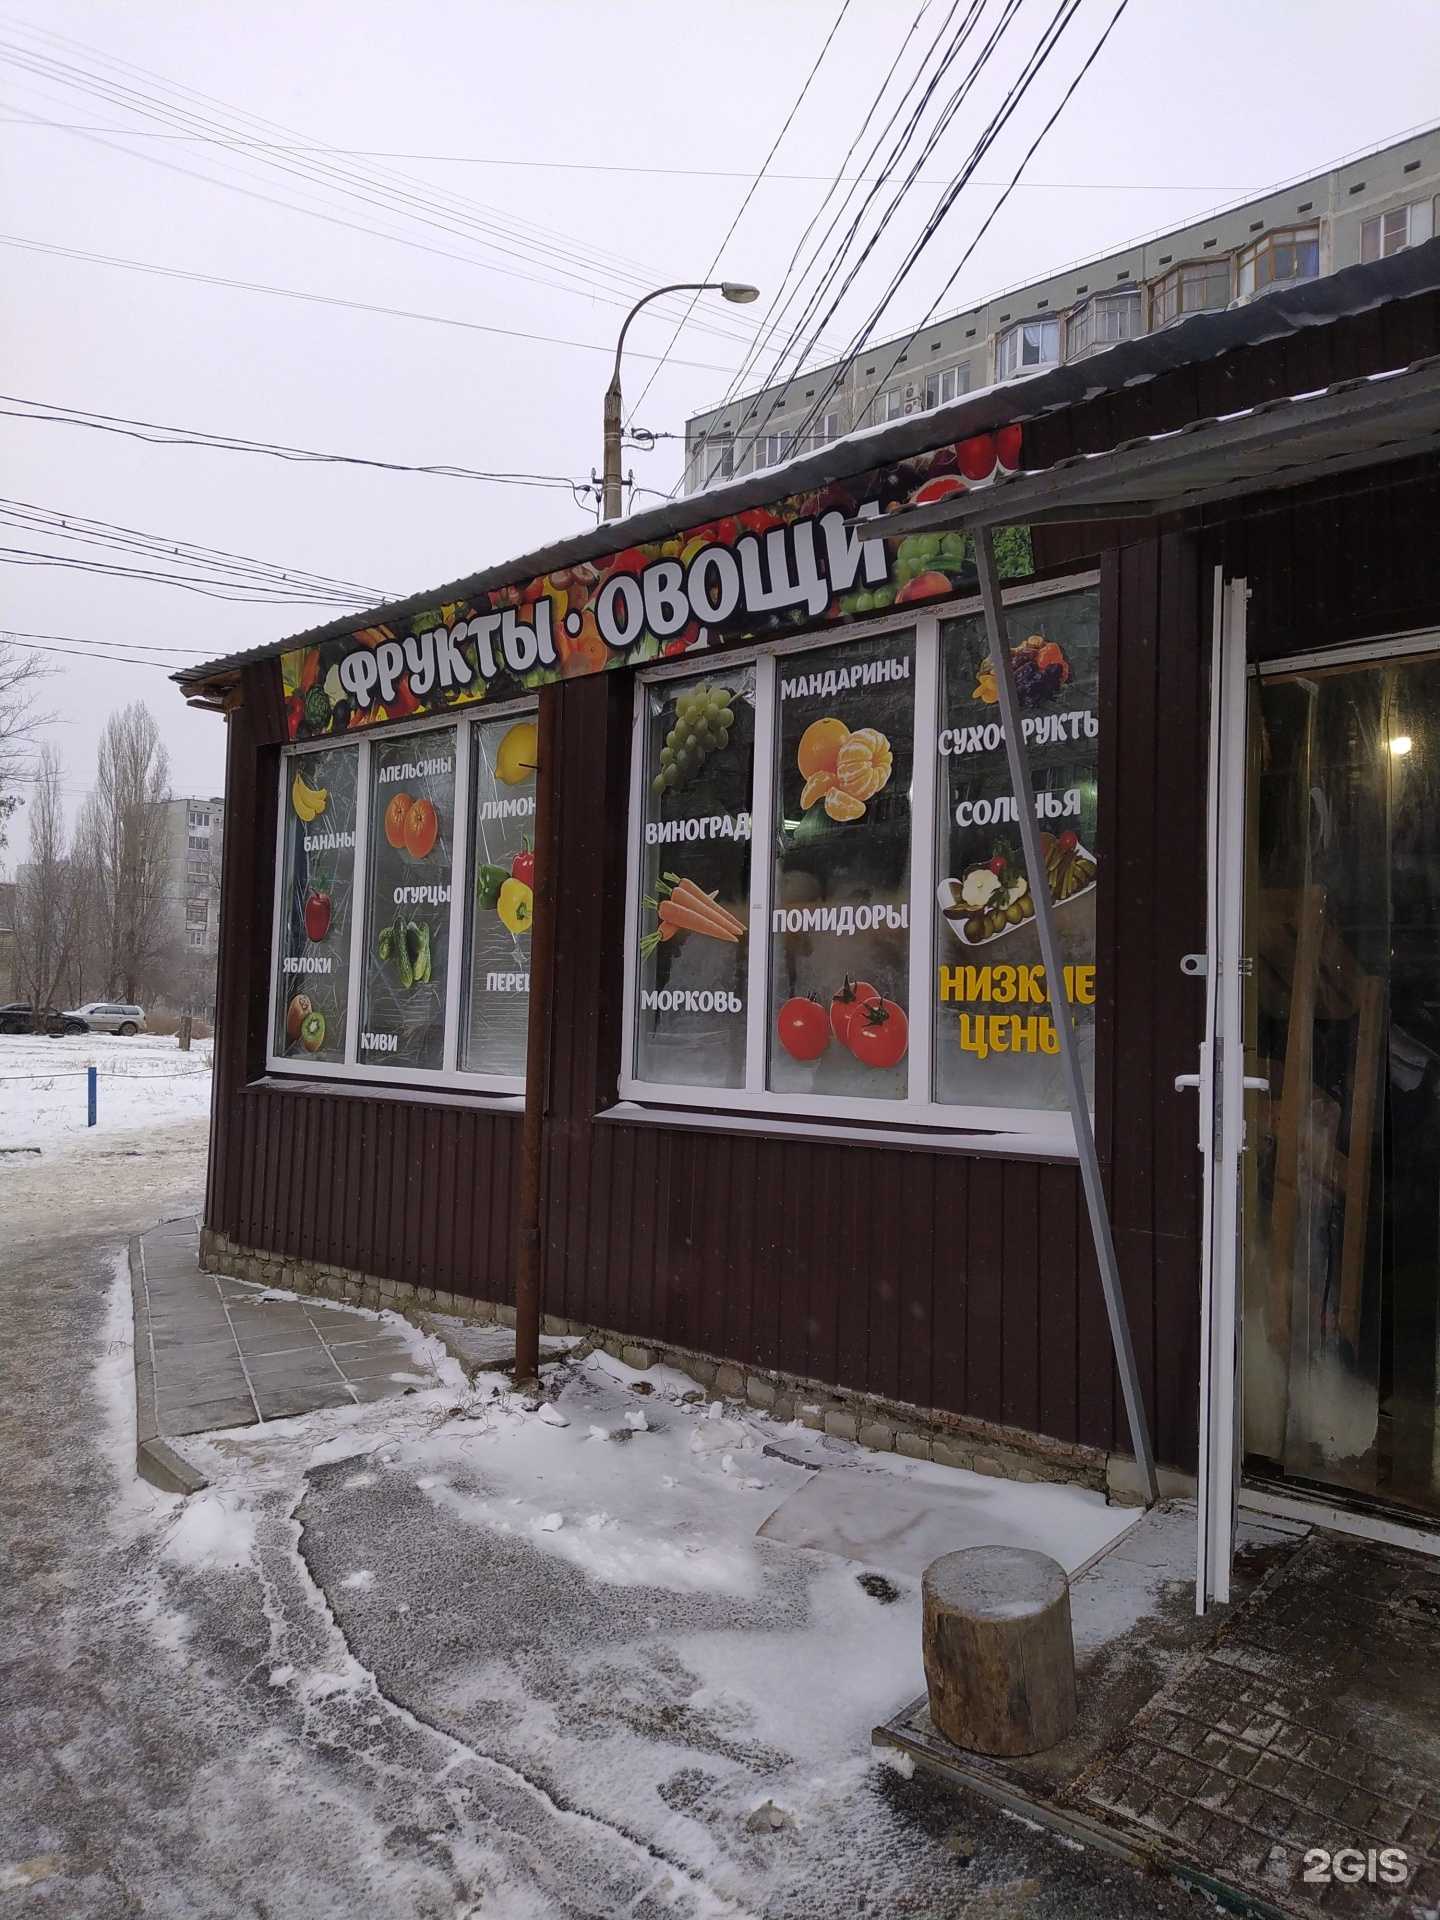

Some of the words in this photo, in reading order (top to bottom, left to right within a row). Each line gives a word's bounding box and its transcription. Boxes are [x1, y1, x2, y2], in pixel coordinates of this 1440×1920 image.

[339, 597, 557, 708] ФРУКТЫ
[597, 500, 888, 647] ОВОЩИ
[781, 656, 910, 700] МАНДАРИНЫ
[379, 757, 452, 783] АПЕЛЬСИНЫ
[645, 812, 751, 844] ВИНОГРАД
[303, 831, 356, 852] БАНАНЫ
[393, 885, 451, 906] ОГУРЦЫ
[772, 903, 909, 936] ПОМИДОРЫ
[282, 957, 332, 973] ЯБЛОКИ
[641, 990, 742, 1013] МОРКОВЬ
[360, 1032, 398, 1051] КИВИ
